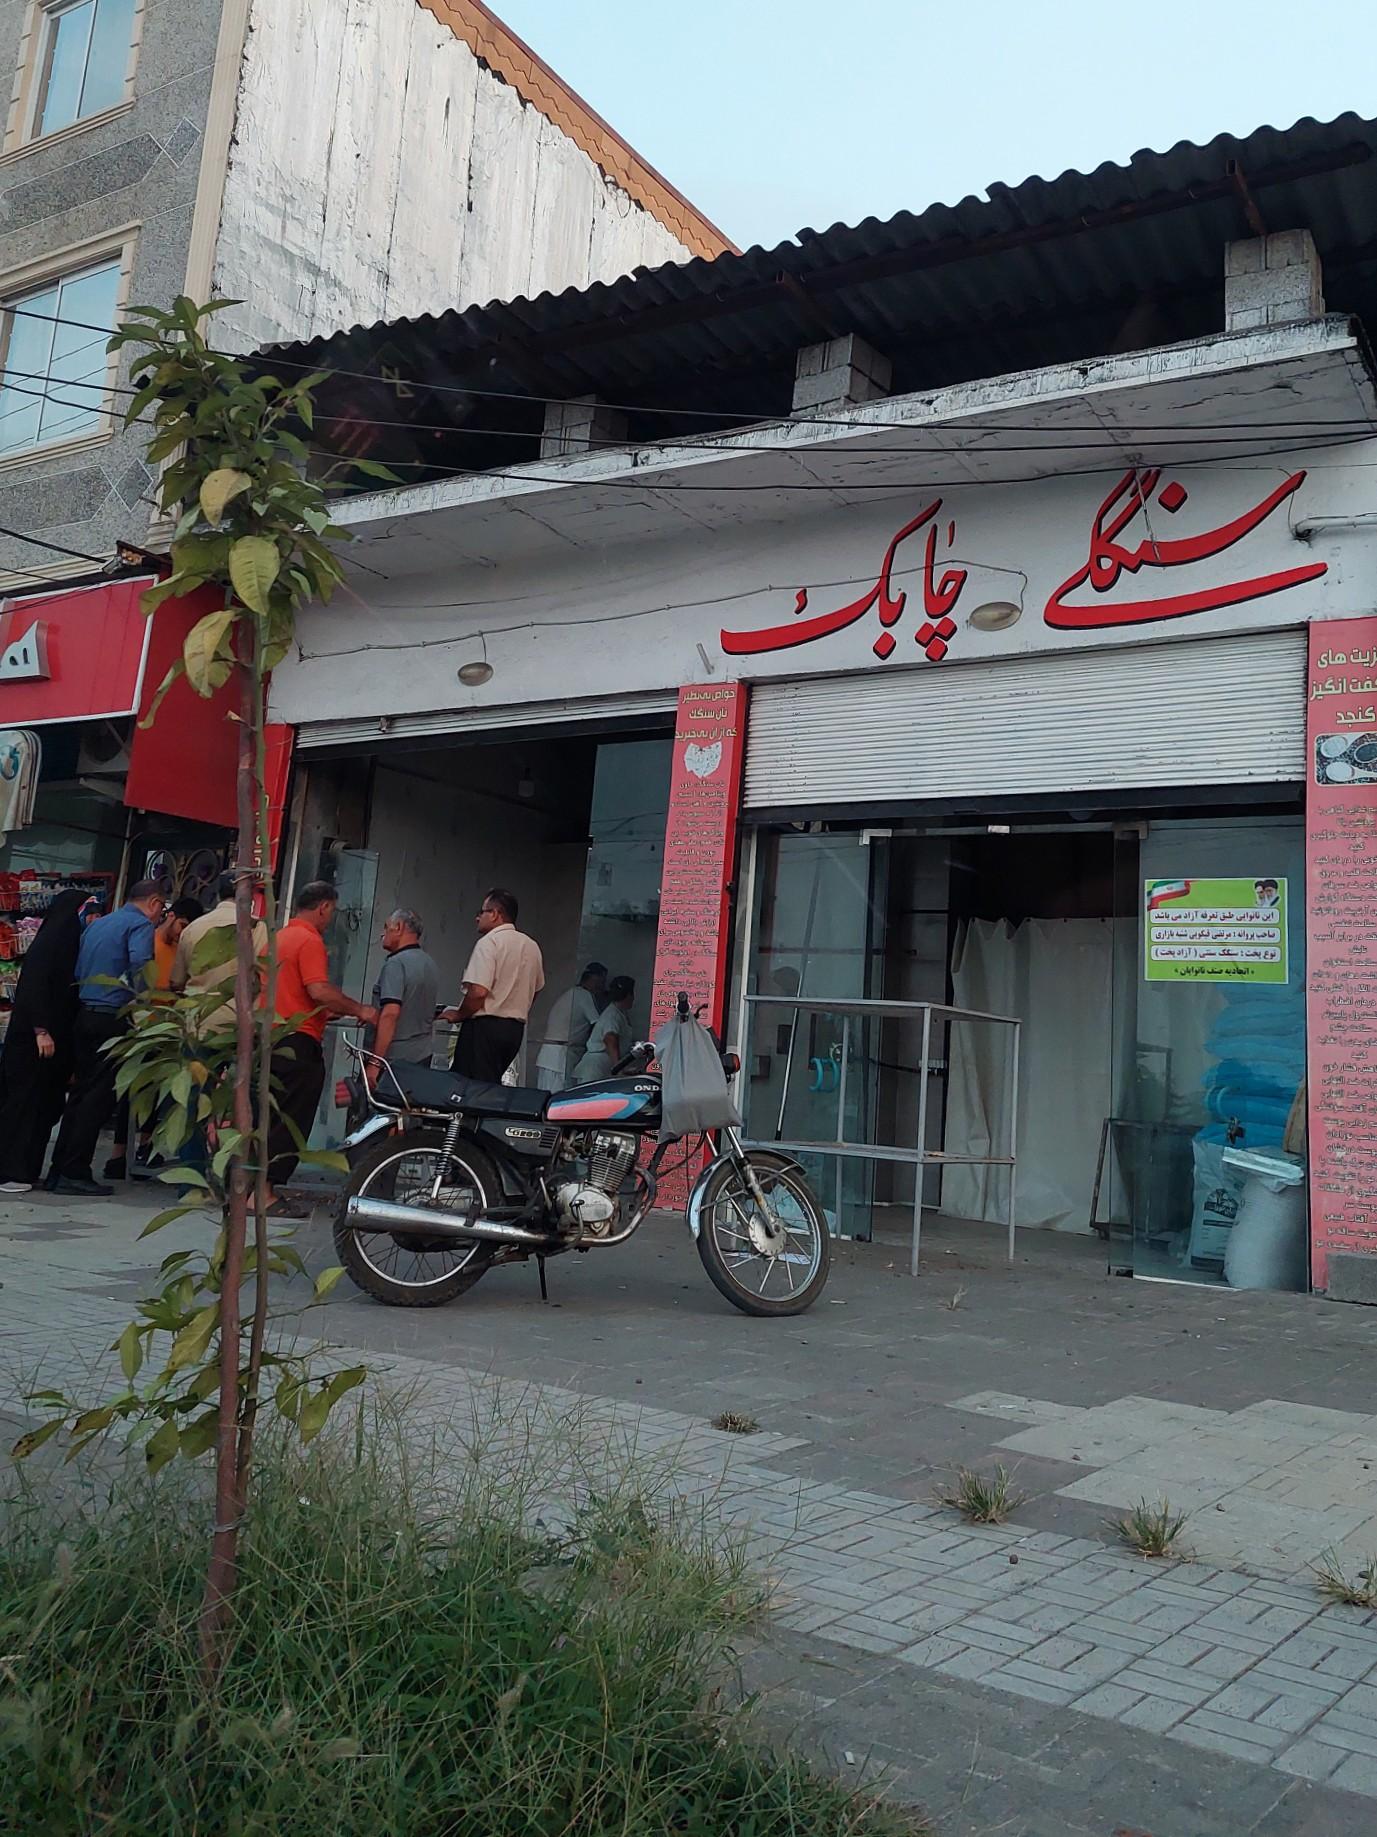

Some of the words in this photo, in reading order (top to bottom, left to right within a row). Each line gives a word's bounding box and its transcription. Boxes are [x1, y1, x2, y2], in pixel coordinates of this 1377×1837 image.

[720, 498, 967, 662] چابک
[1318, 648, 1347, 668] های
[712, 688, 735, 701] خواص
[1310, 676, 1346, 701] انگیز
[689, 708, 715, 719] سنگک
[716, 707, 728, 720] نان
[1336, 706, 1376, 728] کنجد
[1184, 910, 1199, 921] آزاد
[1262, 912, 1274, 921] این
